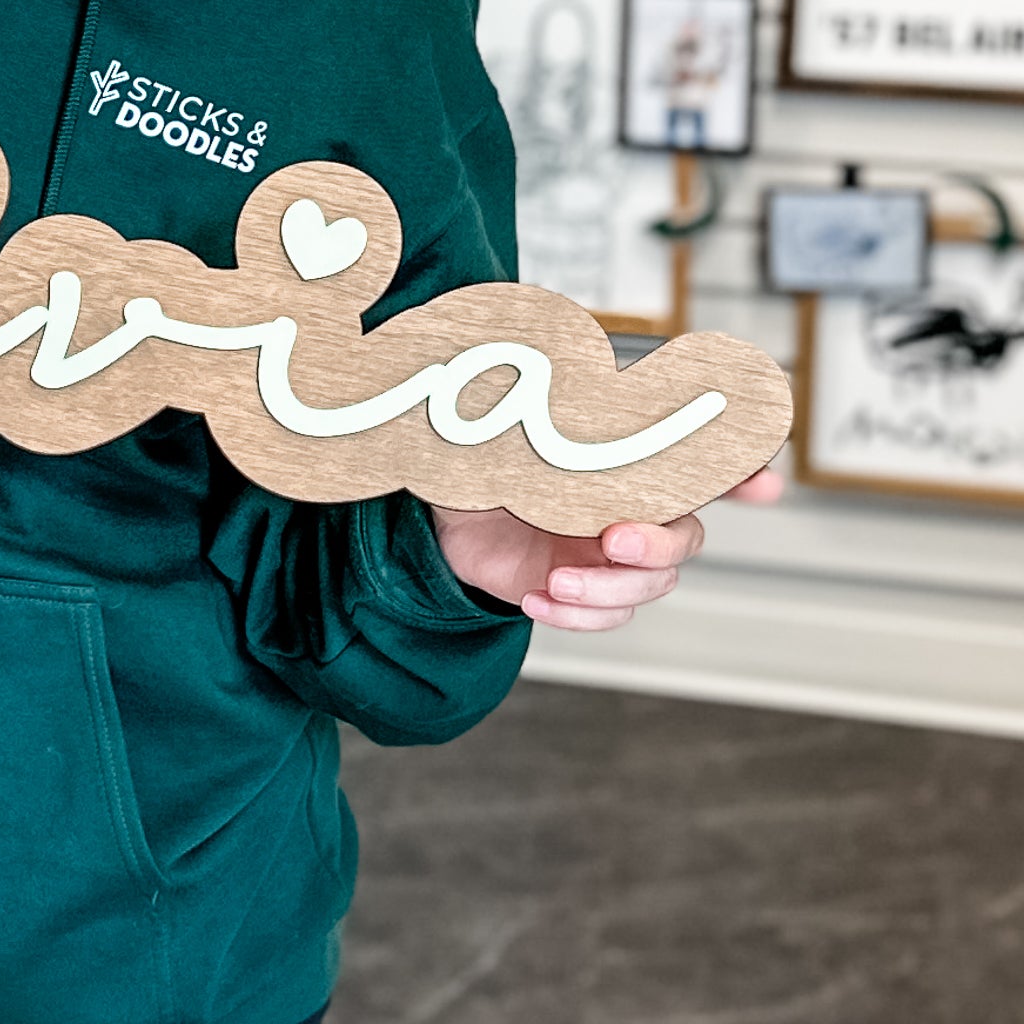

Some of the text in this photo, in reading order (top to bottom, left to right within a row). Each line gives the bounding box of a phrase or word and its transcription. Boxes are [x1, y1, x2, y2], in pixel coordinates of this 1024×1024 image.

[115, 100, 259, 173] DOODLES
[127, 76, 268, 147] STICKS &
